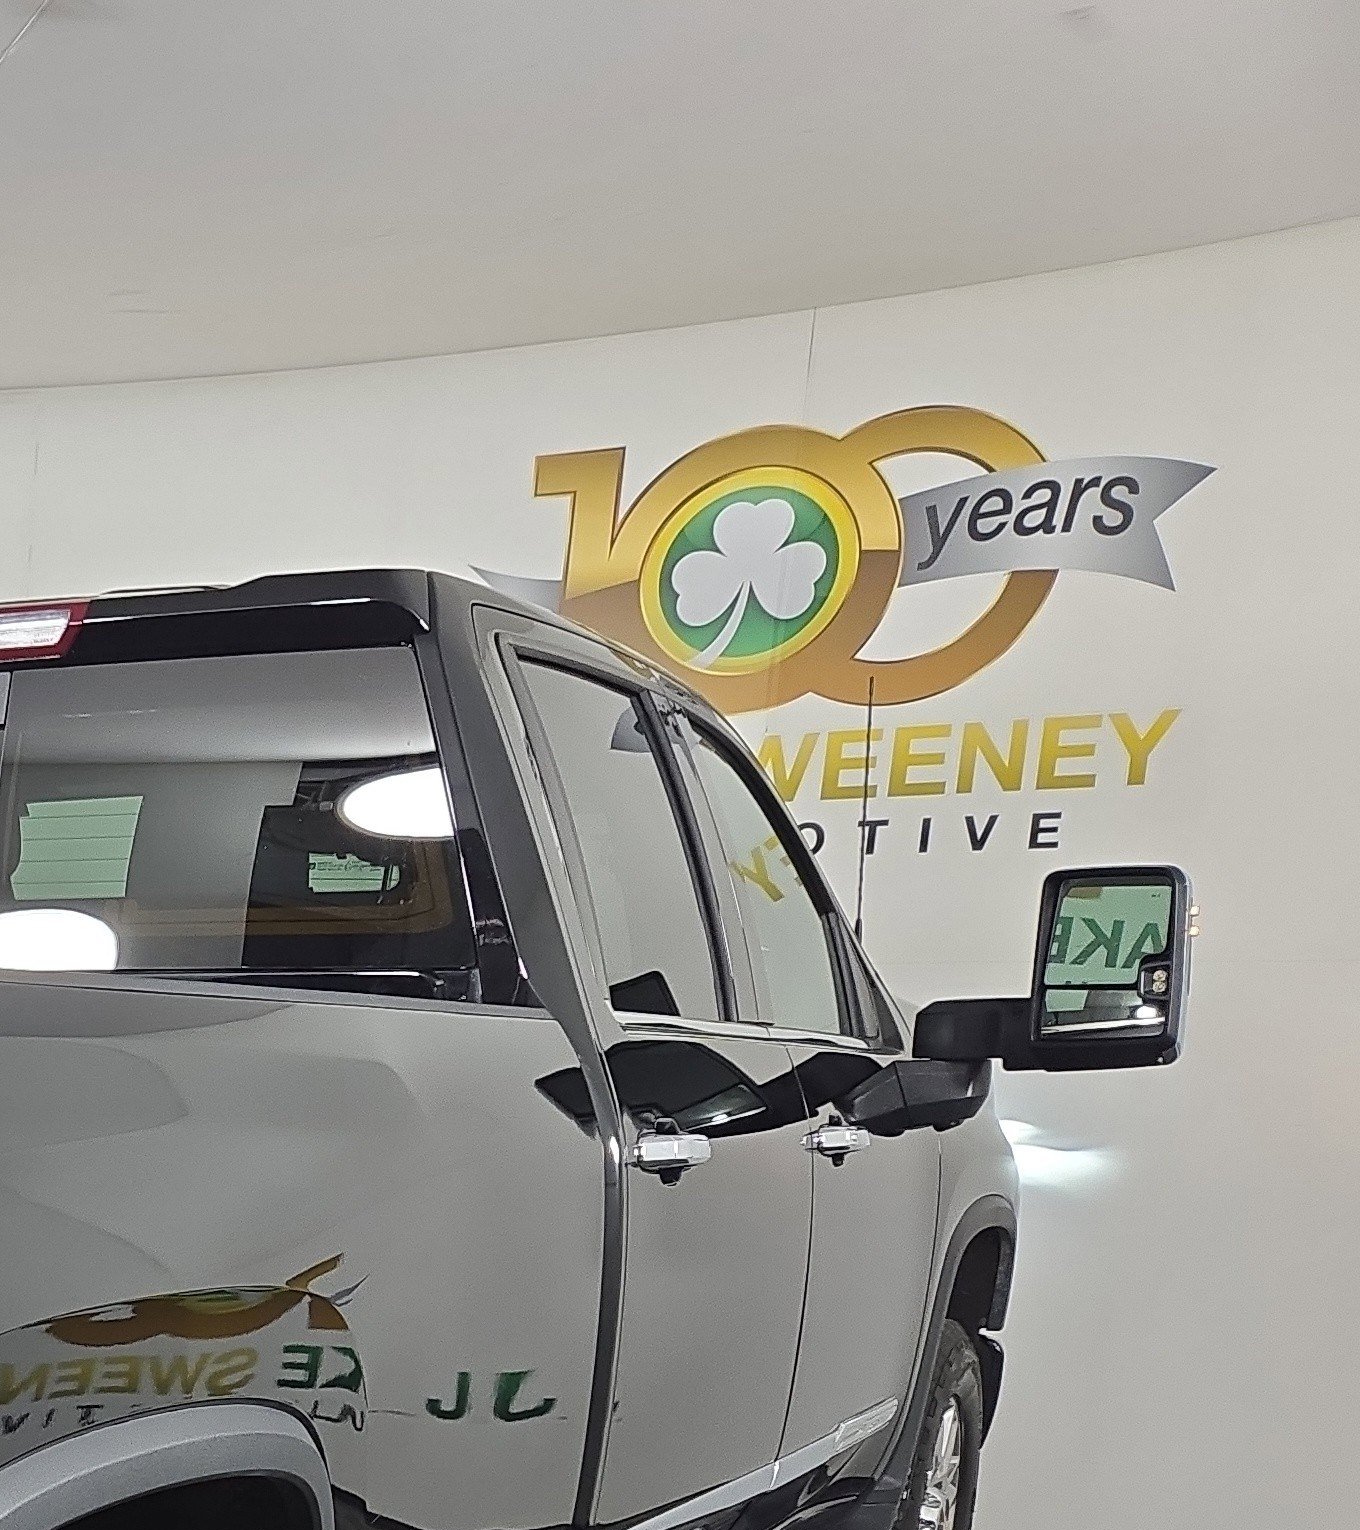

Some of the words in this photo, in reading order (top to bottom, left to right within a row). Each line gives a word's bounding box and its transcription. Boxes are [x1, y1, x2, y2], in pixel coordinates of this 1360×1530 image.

[916, 473, 1141, 573] years
[753, 707, 1183, 802] WEENEY
[798, 811, 1064, 857] OTIVE
